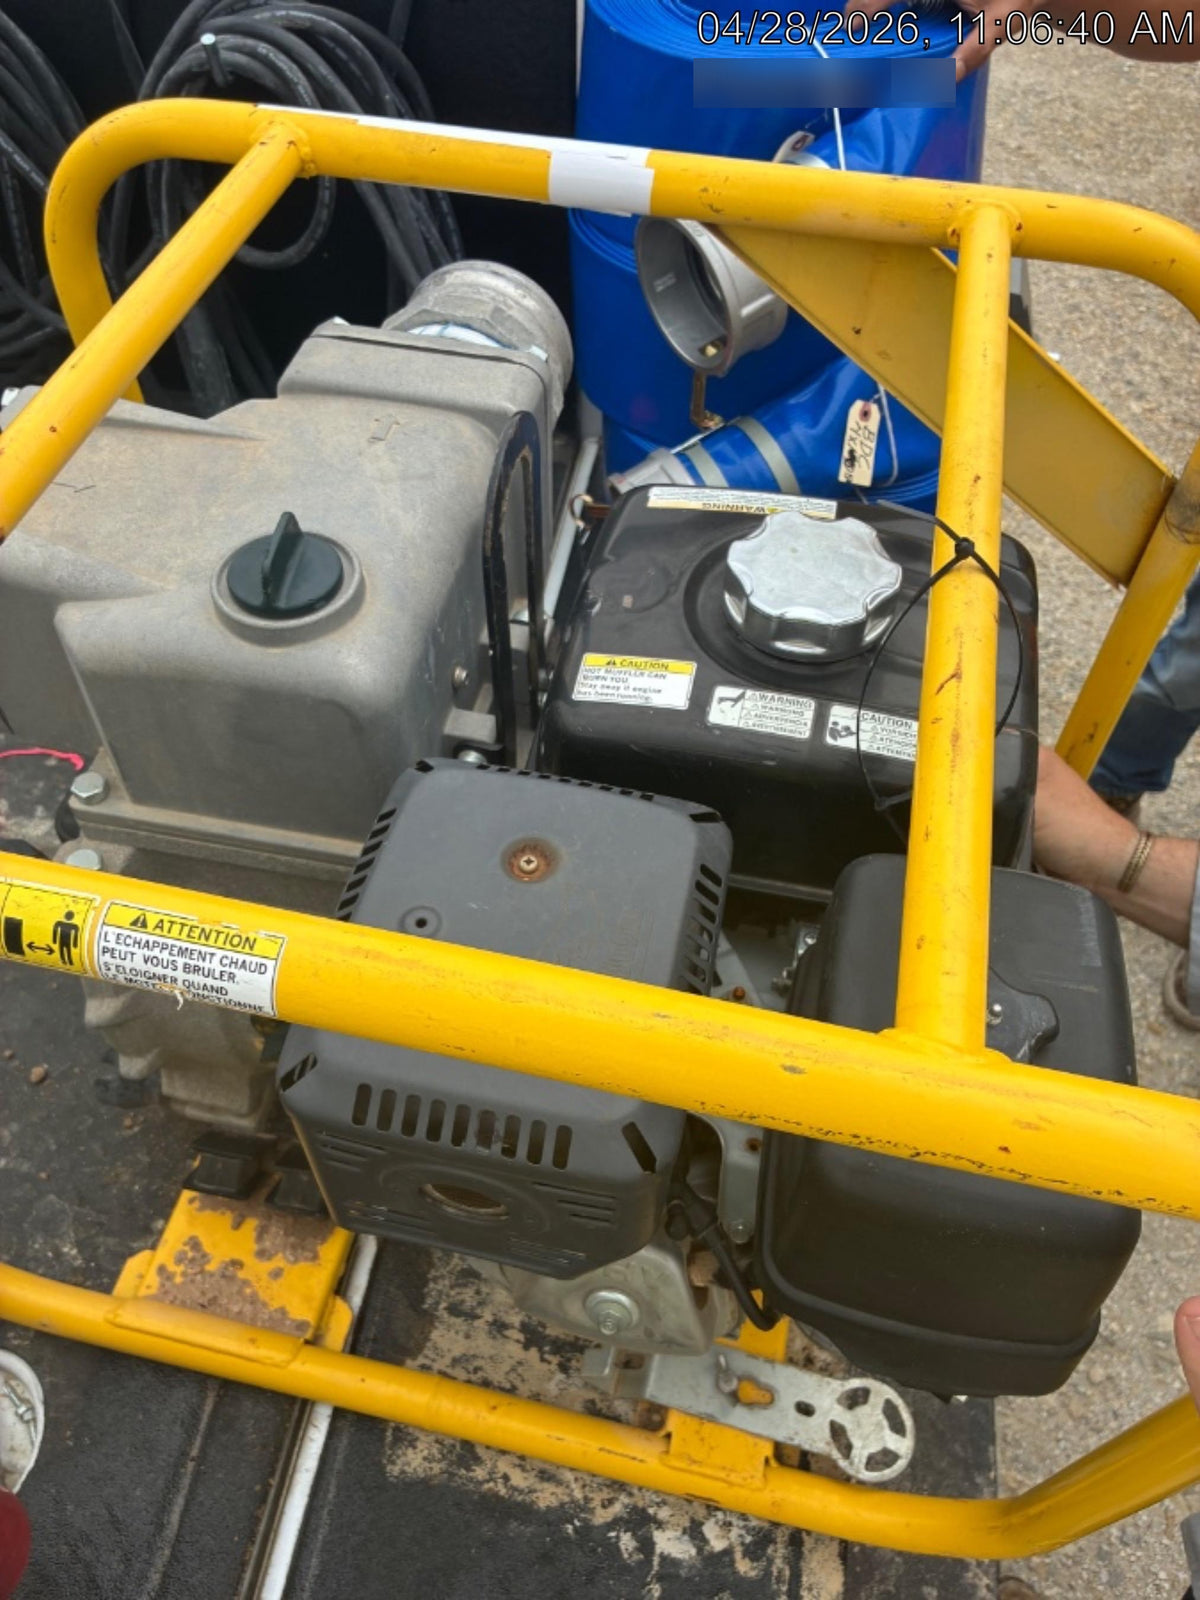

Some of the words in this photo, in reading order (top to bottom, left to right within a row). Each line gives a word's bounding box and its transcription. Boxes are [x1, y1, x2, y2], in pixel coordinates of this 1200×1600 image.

[619, 659, 670, 671] CAUTION
[758, 692, 812, 709] WARNING
[861, 712, 913, 730] CAUTION
[153, 918, 257, 950] ATTENTION
[102, 945, 136, 961] PEUT
[143, 954, 179, 972] VOUS
[182, 961, 240, 985] BRULER.
[103, 930, 217, 965] L'ECHAPPEMENT
[219, 955, 268, 976] CHAUD
[102, 961, 179, 986] S'ELOIGNER
[182, 980, 229, 997] QUAND
